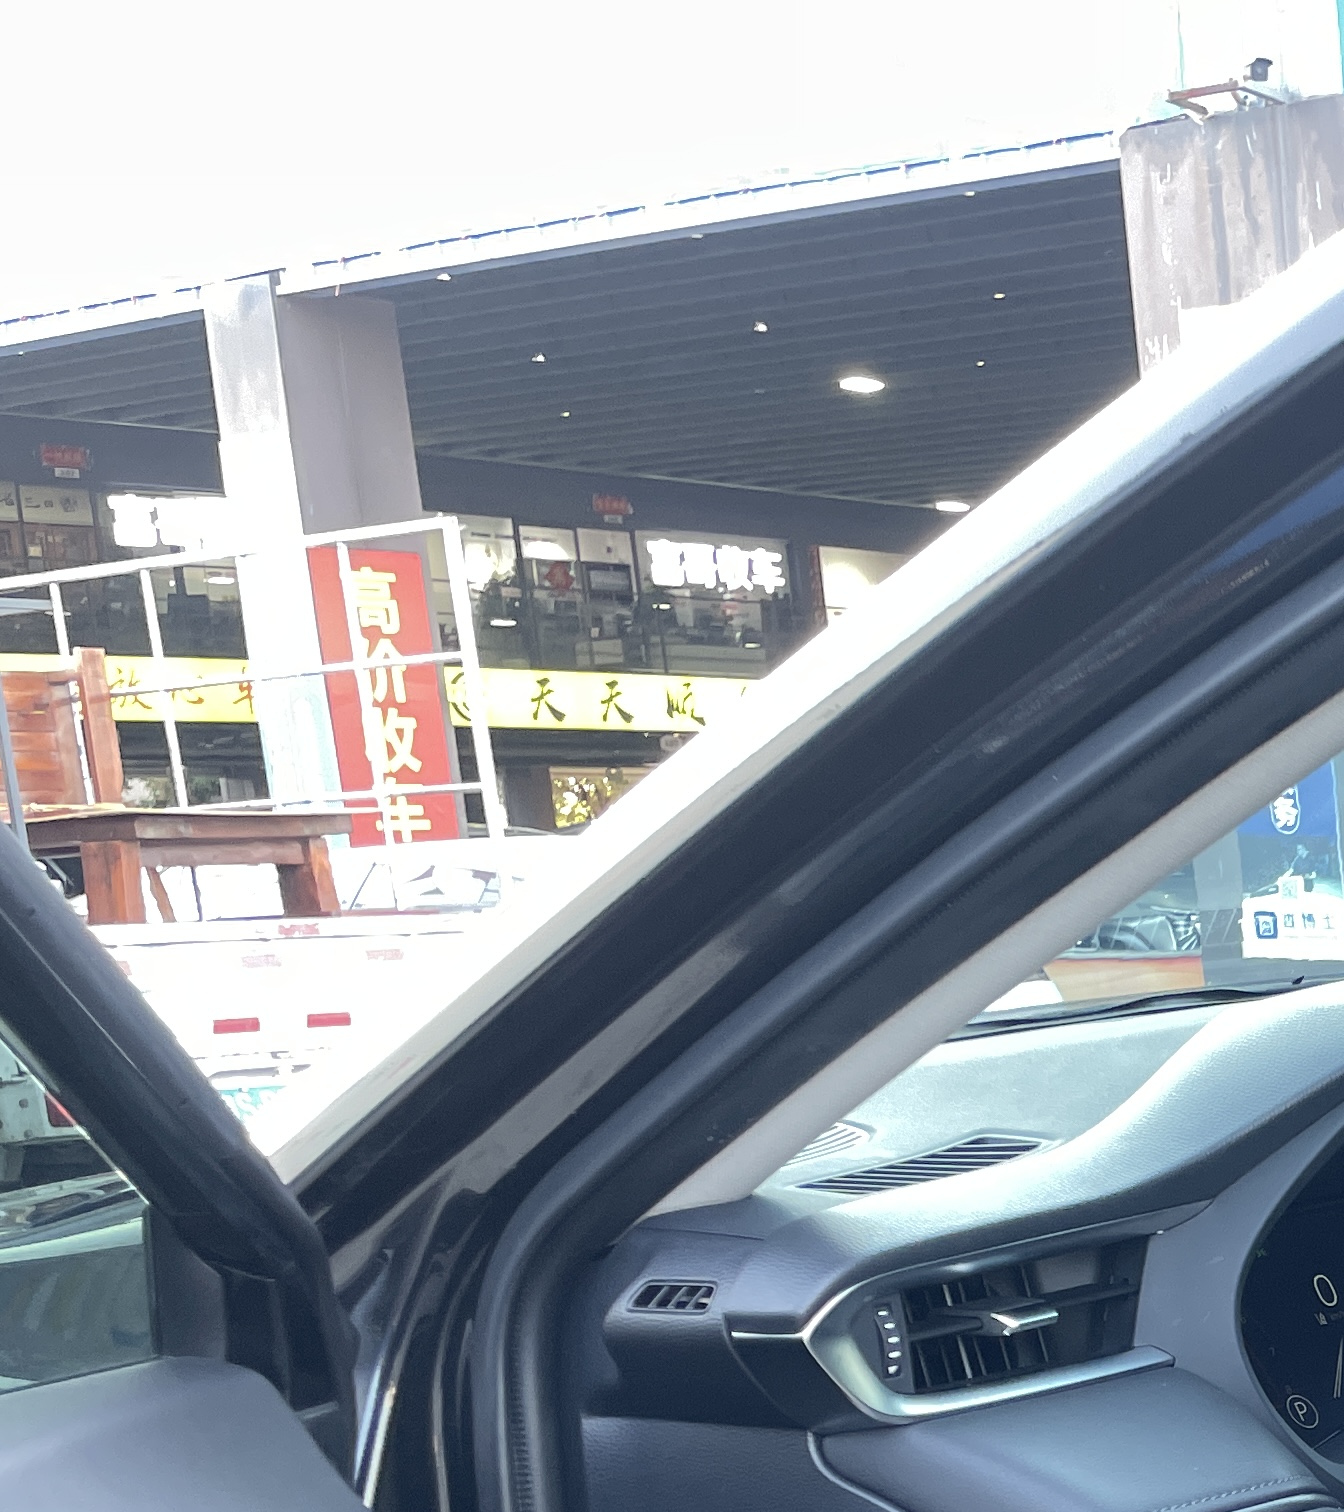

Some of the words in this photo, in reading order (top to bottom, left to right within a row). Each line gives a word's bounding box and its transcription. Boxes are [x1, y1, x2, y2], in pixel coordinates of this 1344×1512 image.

[530, 676, 746, 726] 天天顺
[1313, 1273, 1338, 1307] 0
[1293, 1401, 1308, 1422] P
